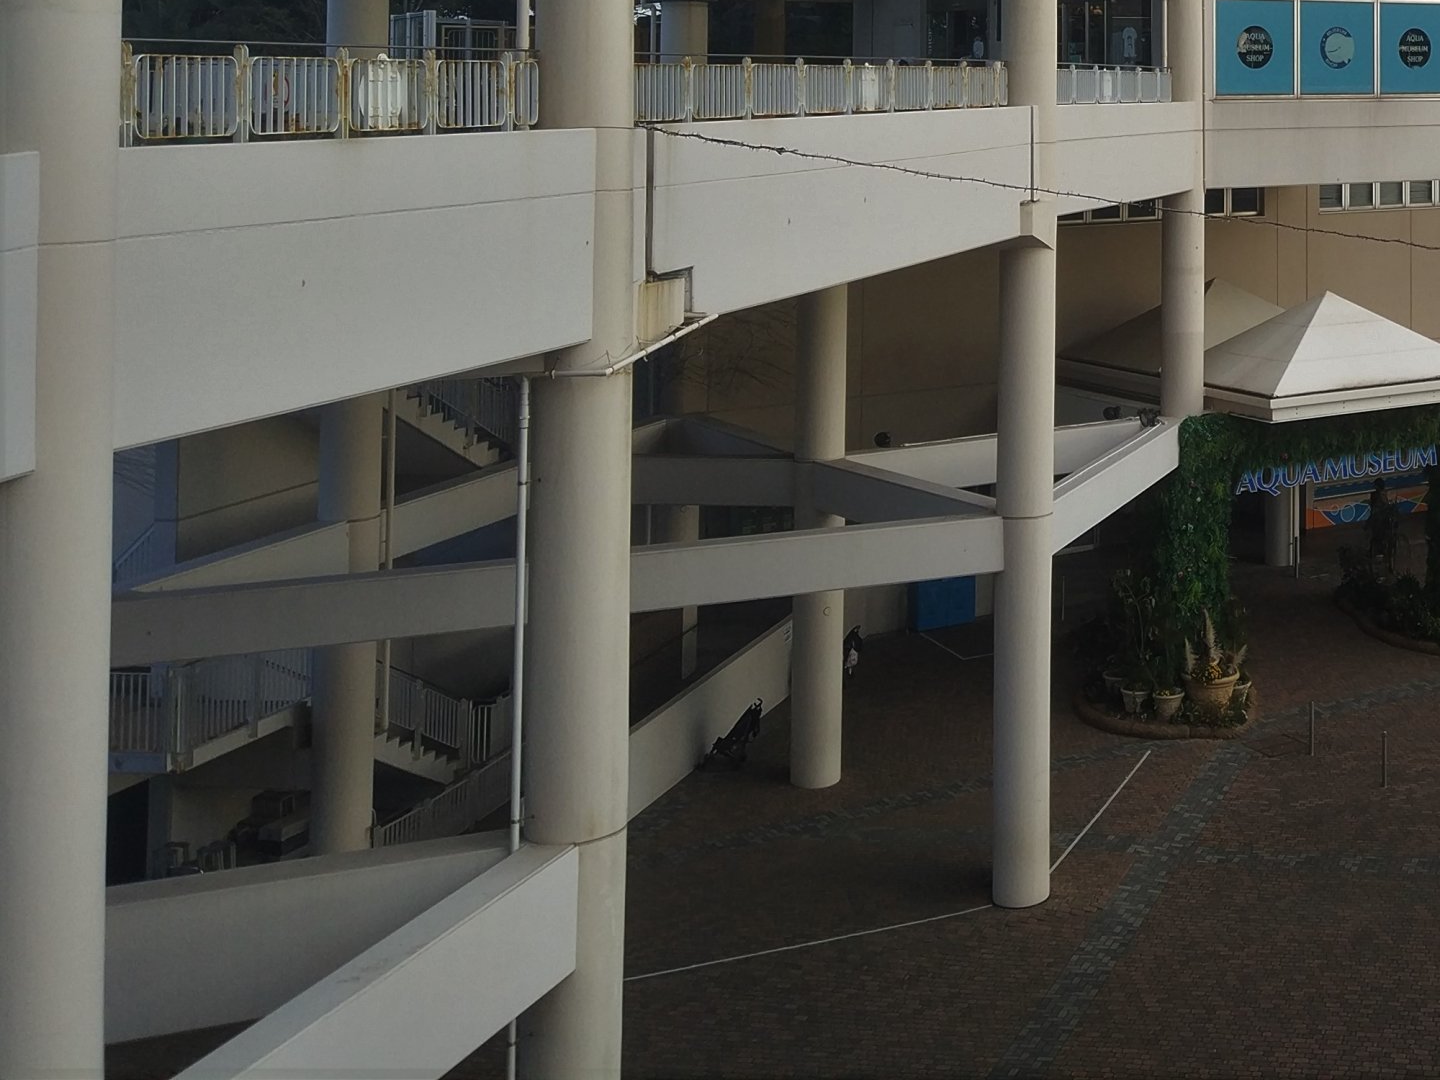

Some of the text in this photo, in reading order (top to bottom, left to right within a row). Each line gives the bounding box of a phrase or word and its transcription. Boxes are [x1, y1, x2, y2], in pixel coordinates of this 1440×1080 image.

[1406, 34, 1424, 42] AQUA
[1246, 54, 1264, 62] SHOP
[1235, 443, 1439, 497] AQUA MUSEUM
